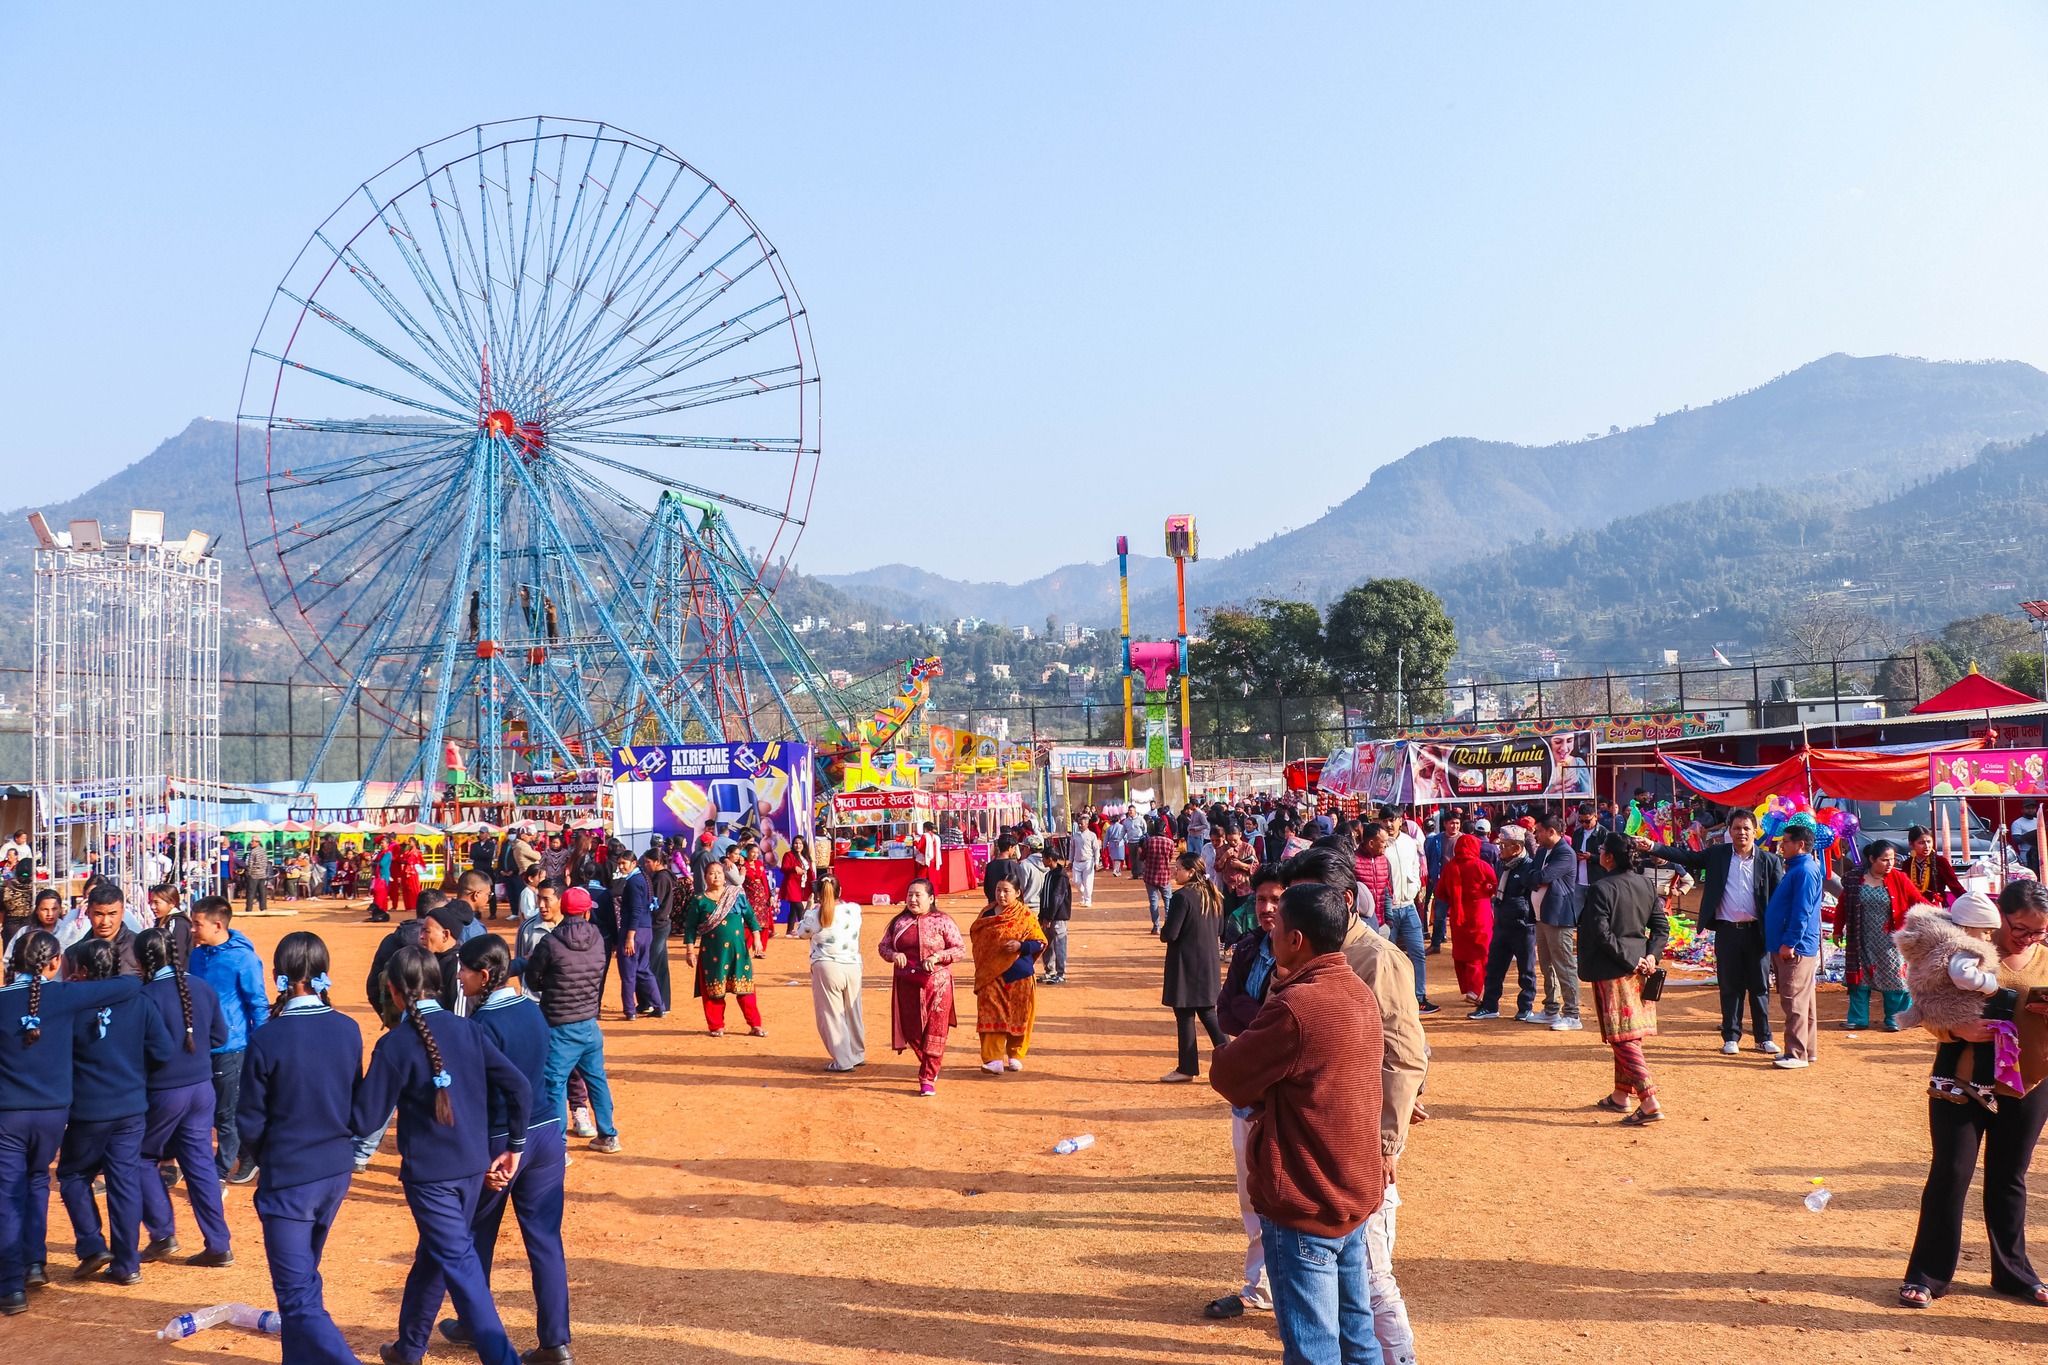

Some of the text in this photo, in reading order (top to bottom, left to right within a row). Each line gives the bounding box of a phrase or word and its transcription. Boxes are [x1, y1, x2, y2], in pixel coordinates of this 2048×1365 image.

[671, 748, 730, 766] XTREME
[1454, 744, 1545, 765] Rolls Mania
[671, 764, 730, 776] ENERGY DRINK
[860, 795, 886, 807] चटपटे
[888, 793, 914, 806] सेन्टर
